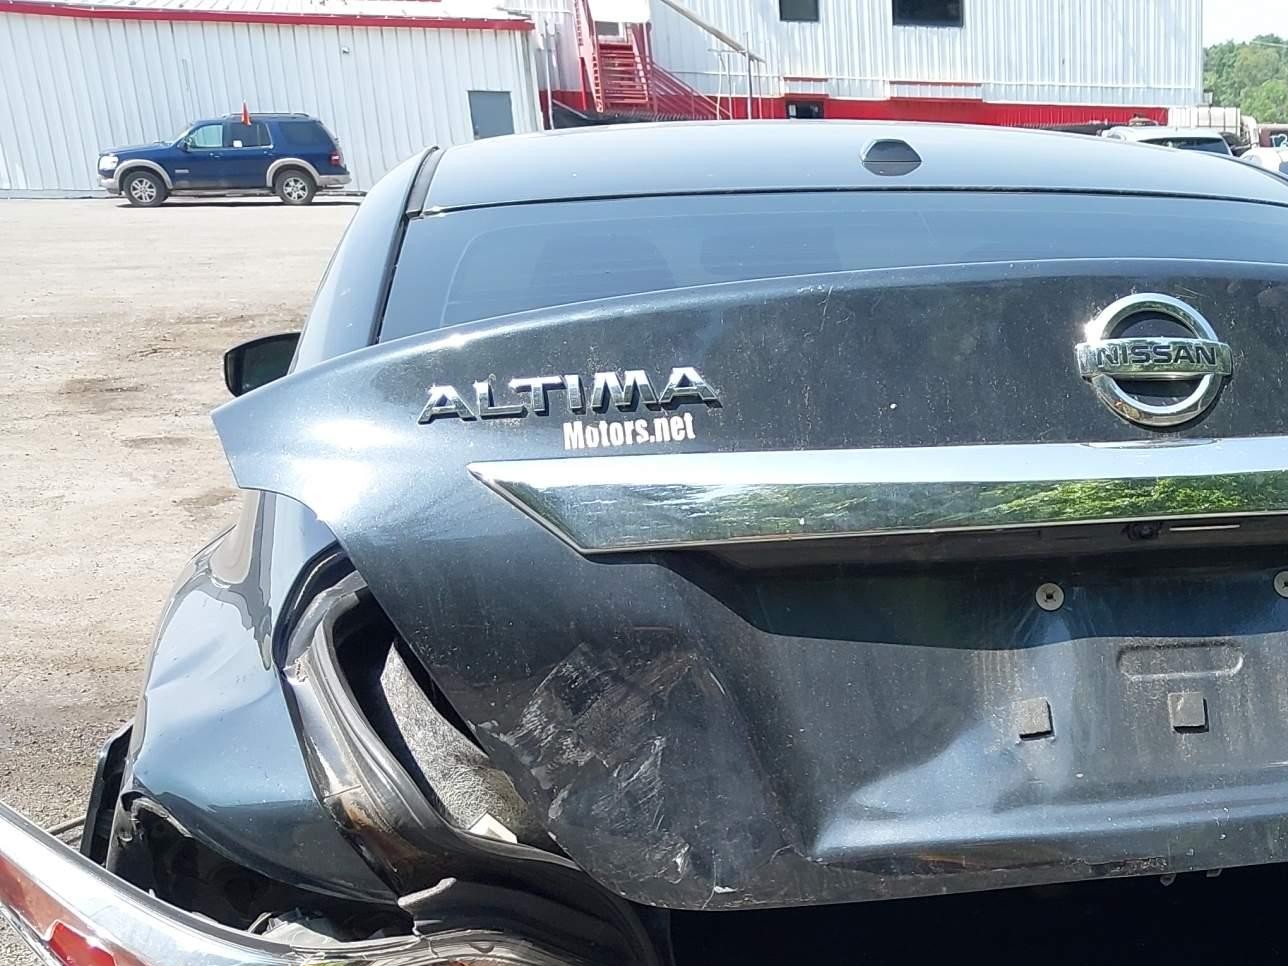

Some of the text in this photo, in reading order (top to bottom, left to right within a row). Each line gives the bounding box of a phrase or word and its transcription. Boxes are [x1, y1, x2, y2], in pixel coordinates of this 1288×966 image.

[1097, 343, 1218, 368] NISSAN
[417, 367, 723, 425] ALTIMA
[563, 412, 697, 450] Motors.net
